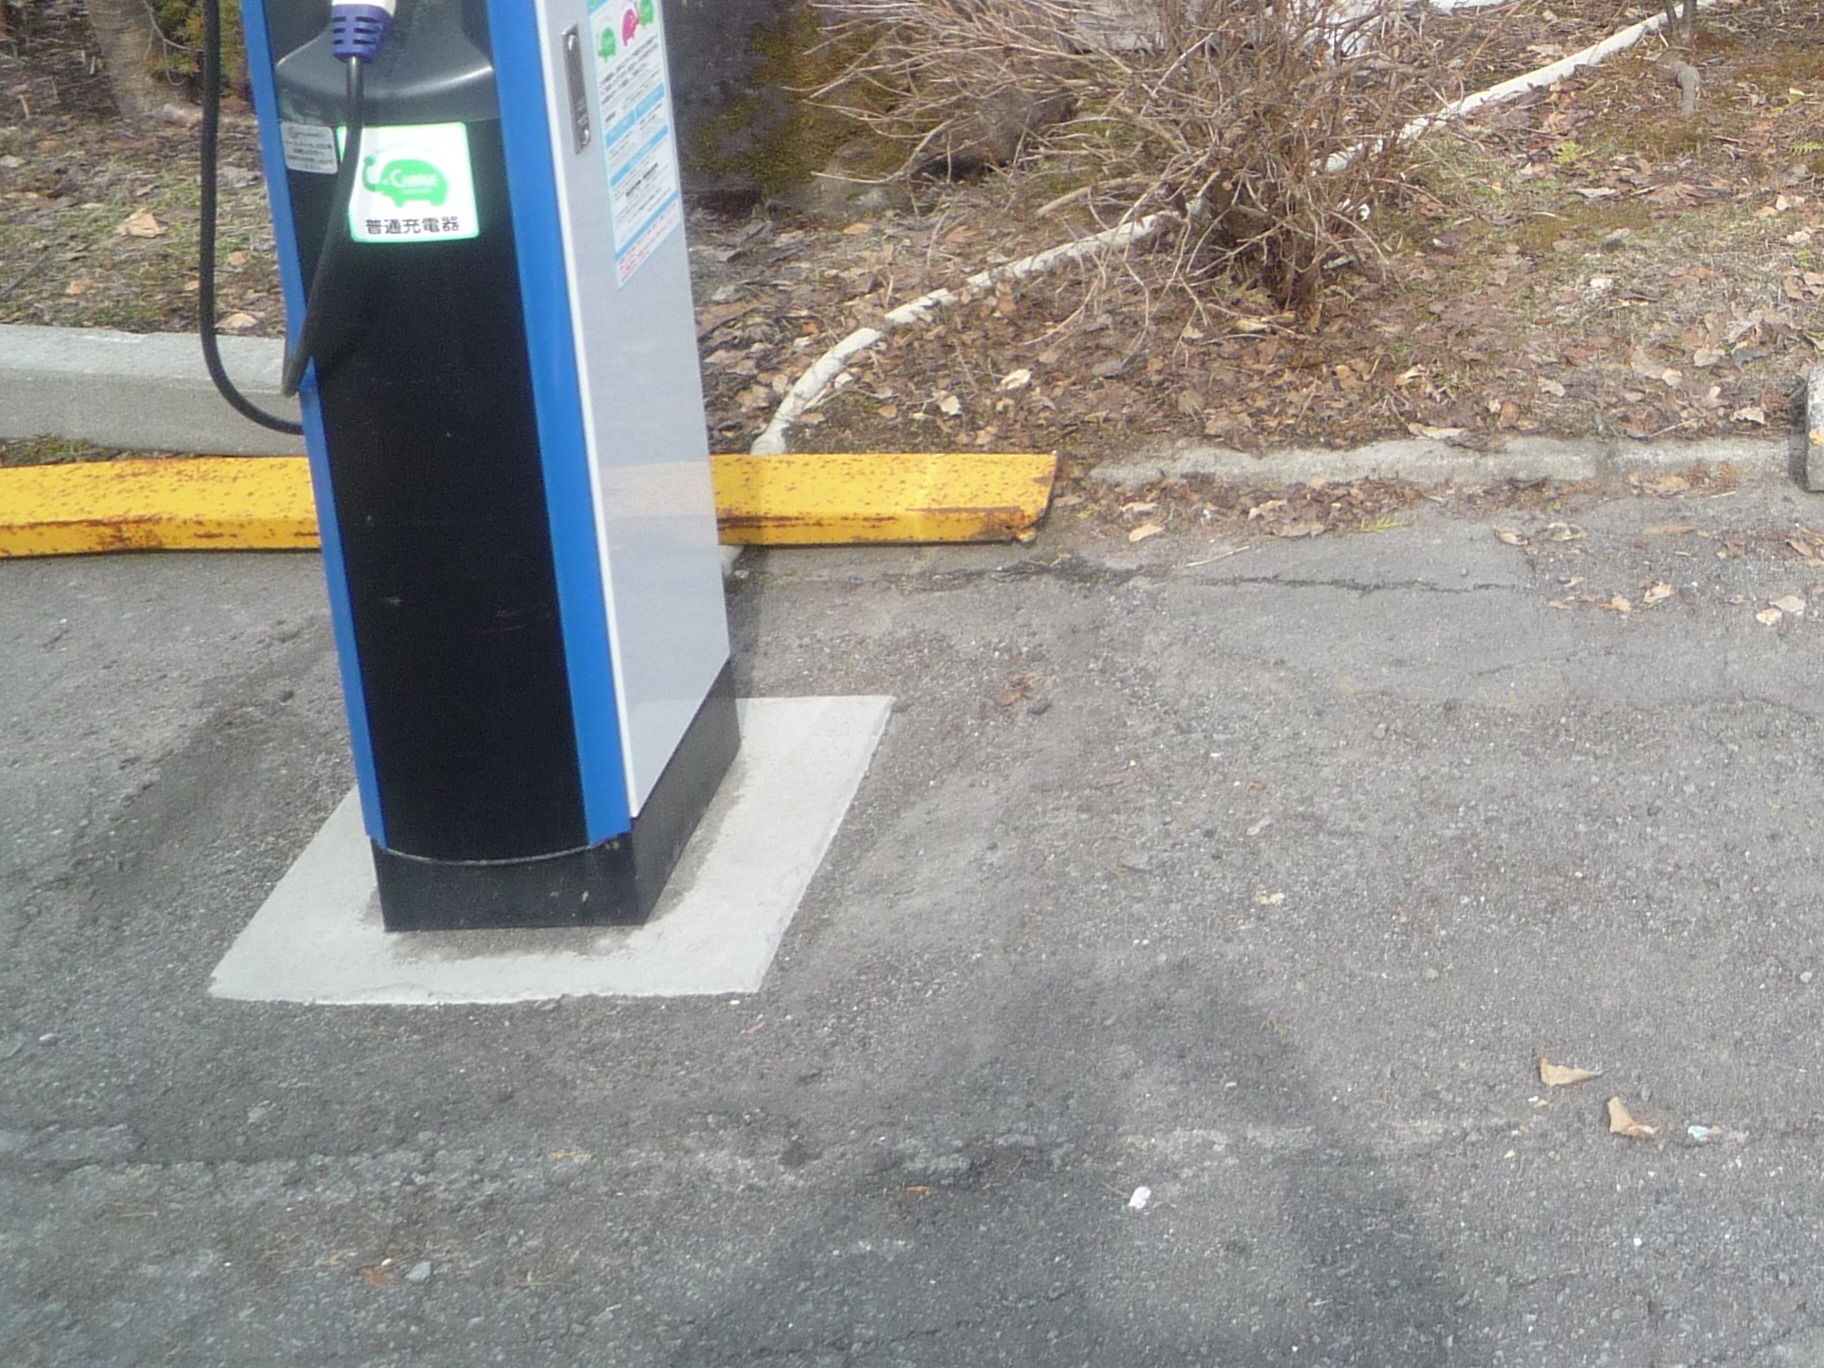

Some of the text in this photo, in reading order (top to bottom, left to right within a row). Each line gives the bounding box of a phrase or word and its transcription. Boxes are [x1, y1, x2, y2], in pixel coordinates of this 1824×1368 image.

[365, 216, 460, 235] 普通充電器
